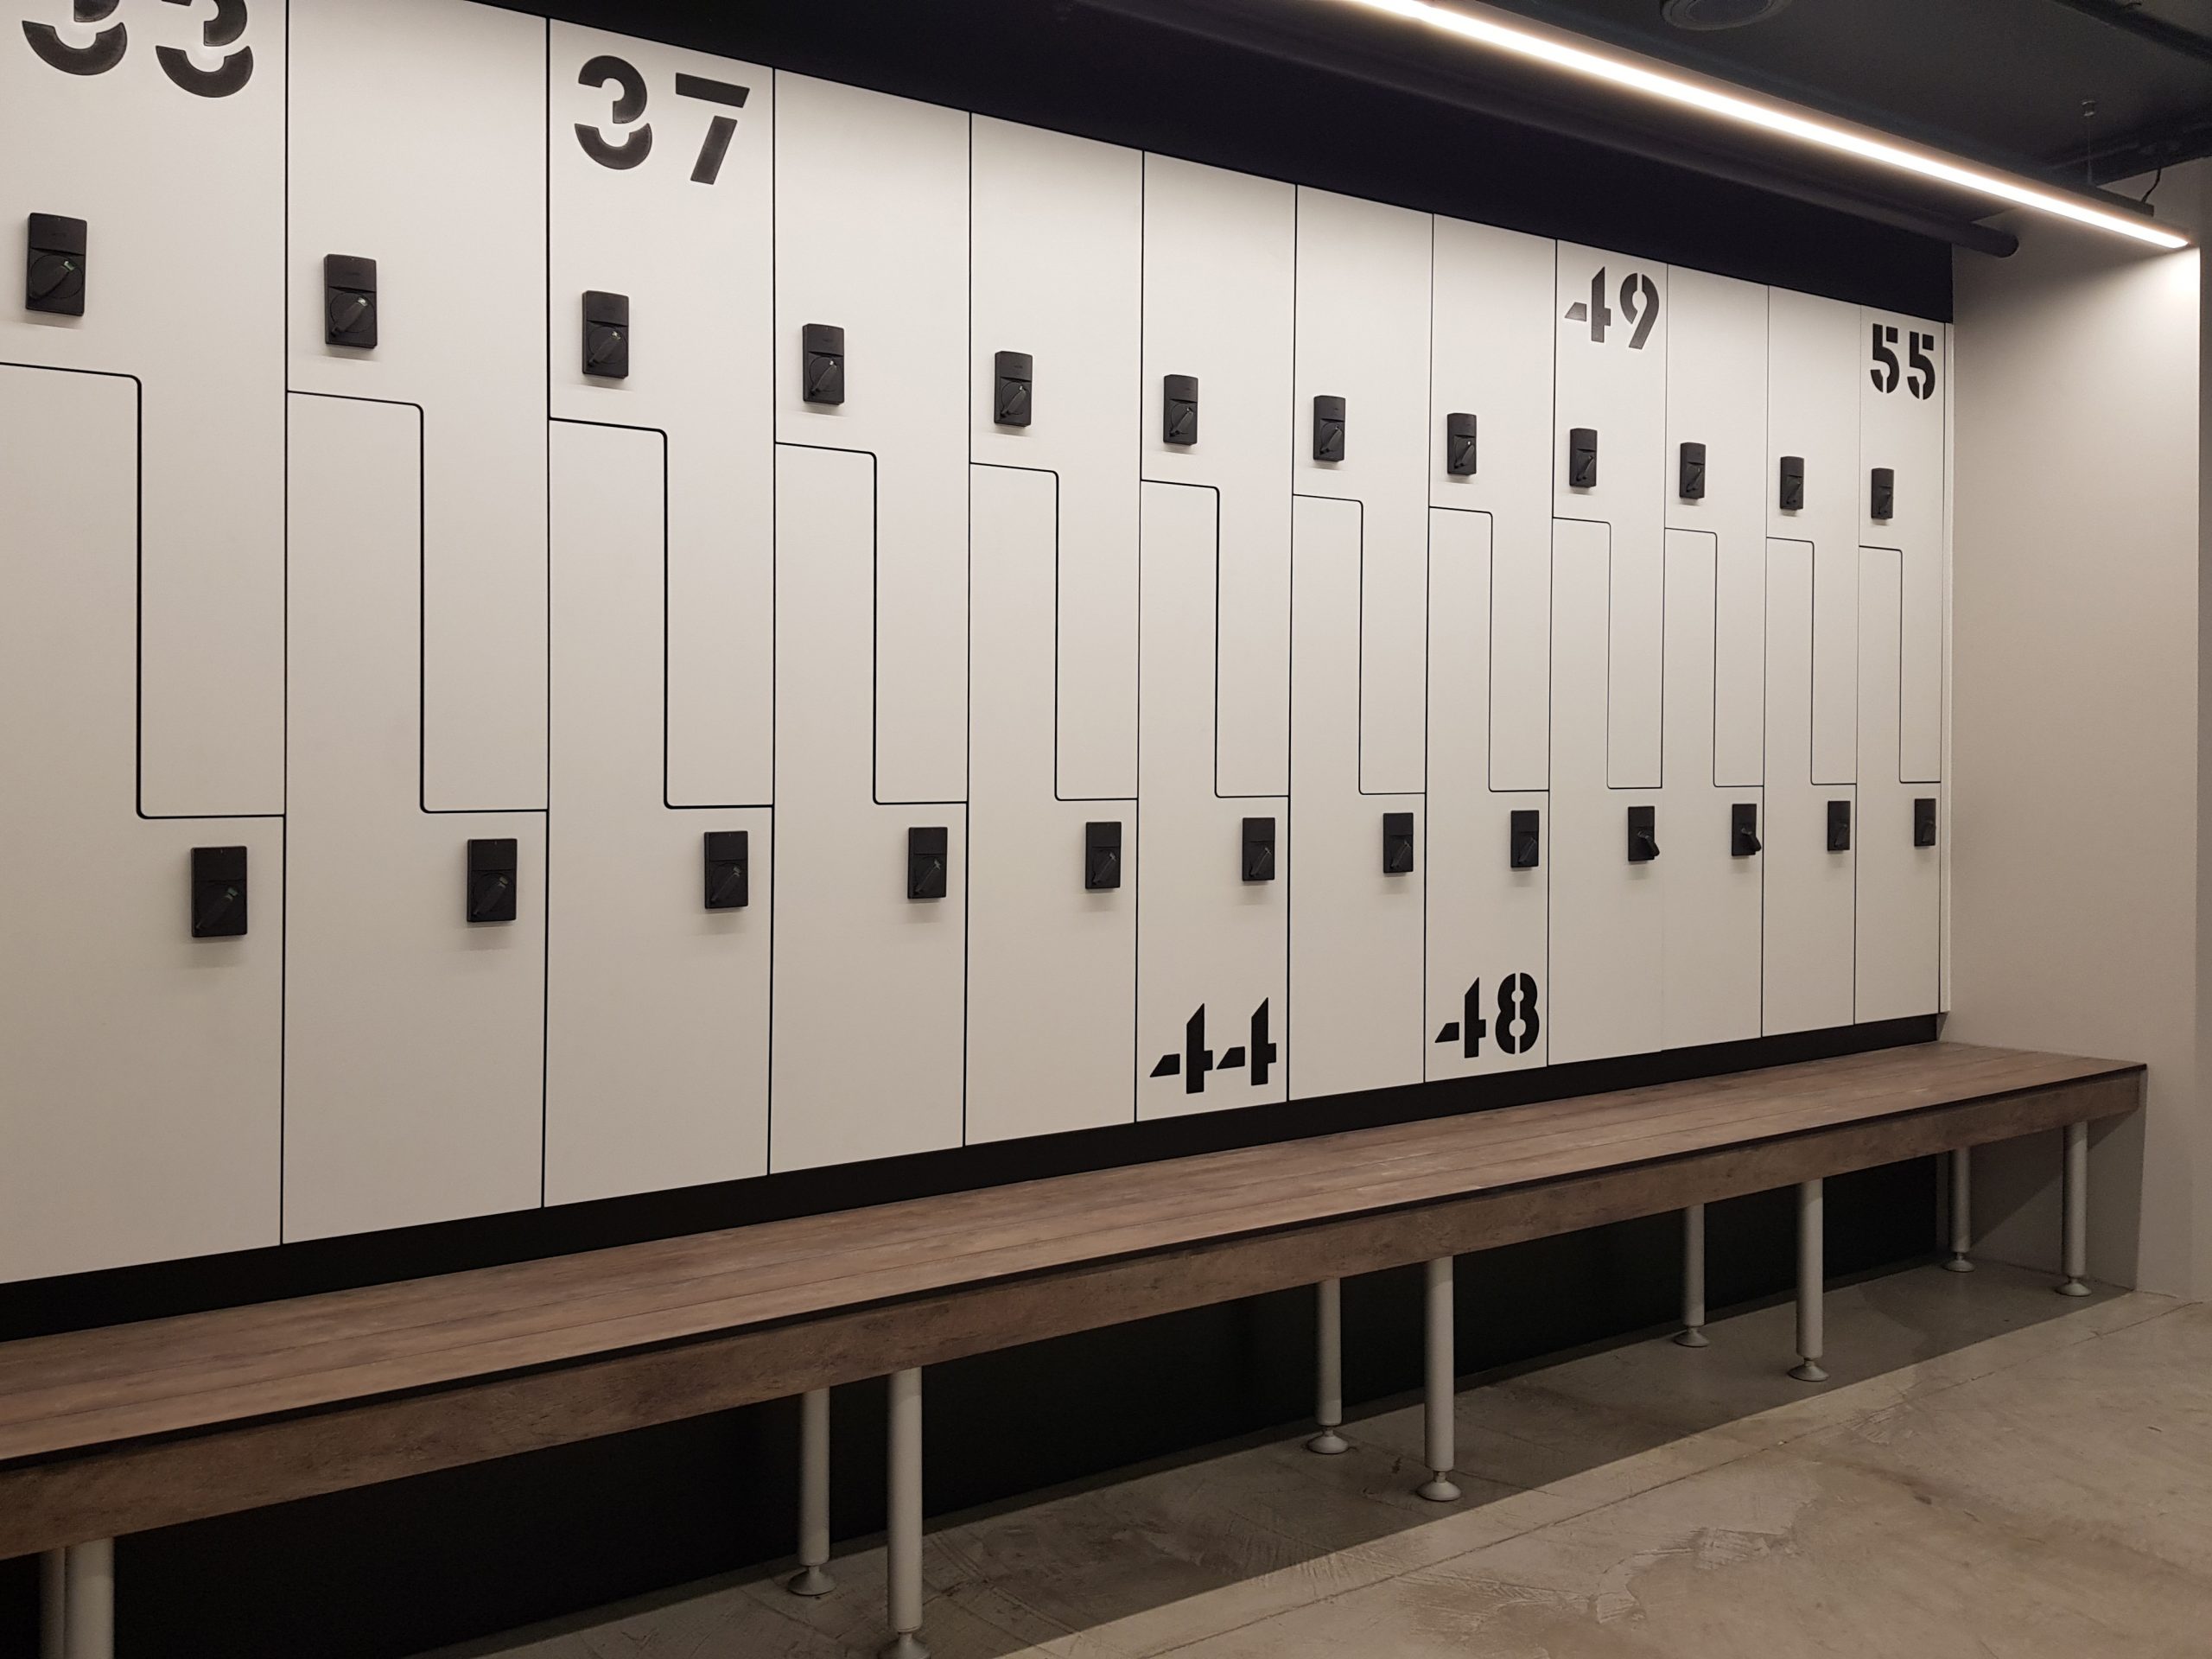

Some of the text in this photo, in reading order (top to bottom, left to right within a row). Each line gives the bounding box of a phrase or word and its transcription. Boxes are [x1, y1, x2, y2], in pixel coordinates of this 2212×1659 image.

[574, 54, 751, 185] 37
[1564, 266, 1660, 350] 49
[1870, 322, 1936, 400] 55
[1149, 996, 1277, 1095] 44
[1434, 972, 1540, 1059] 48
